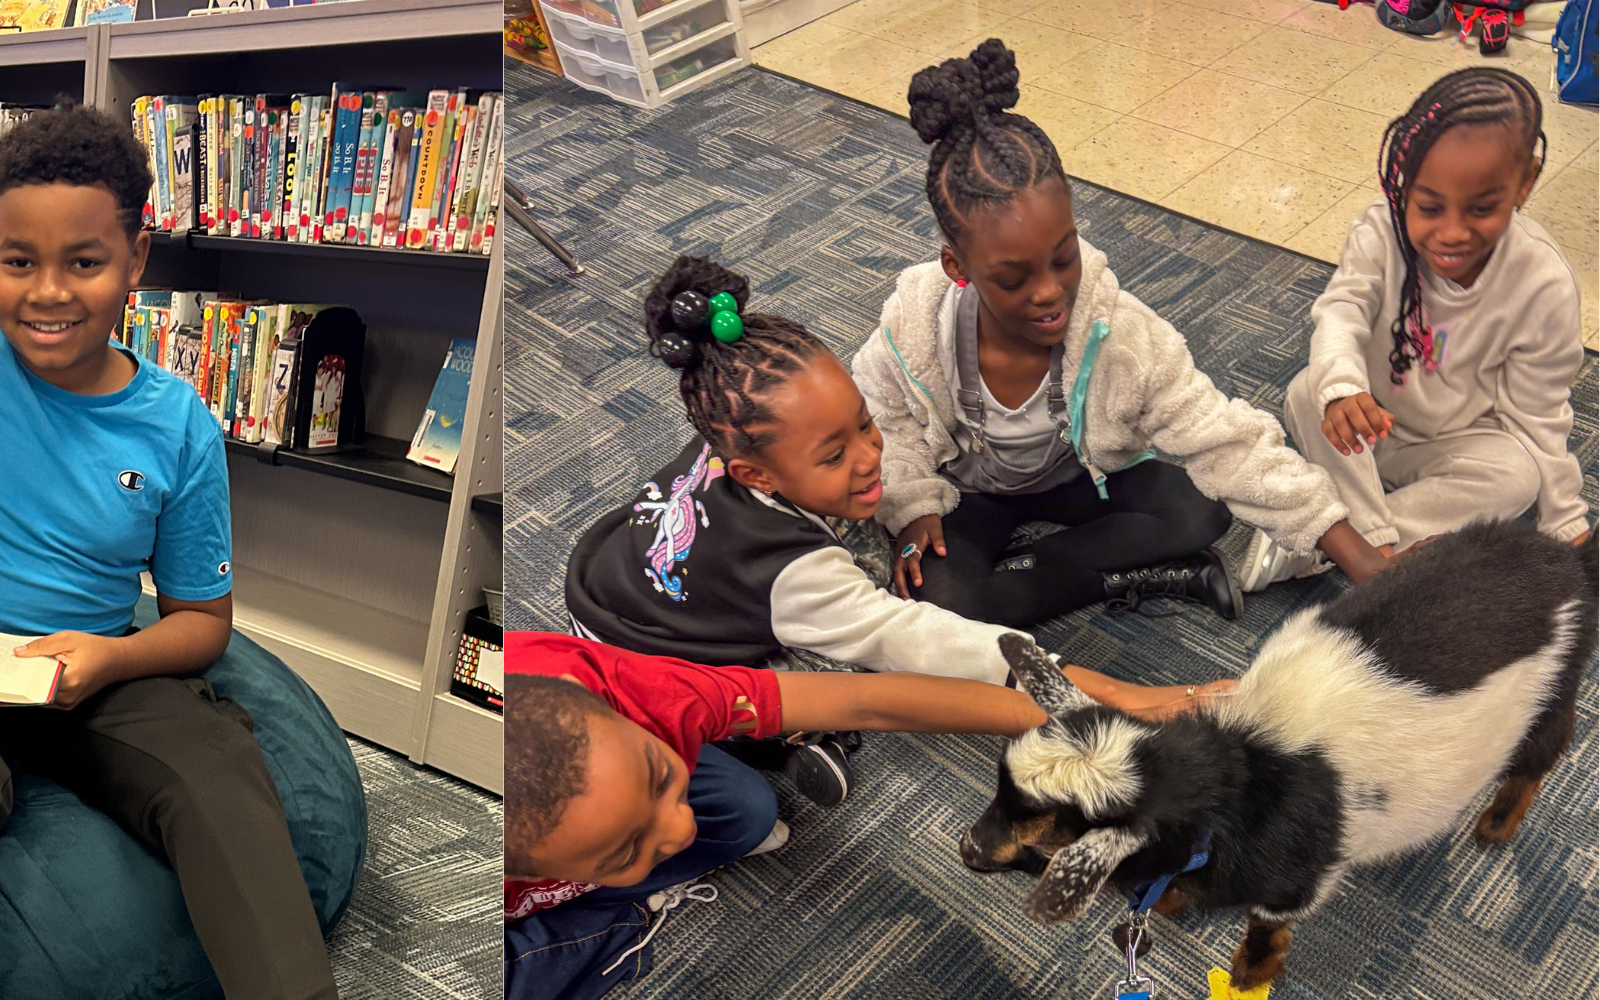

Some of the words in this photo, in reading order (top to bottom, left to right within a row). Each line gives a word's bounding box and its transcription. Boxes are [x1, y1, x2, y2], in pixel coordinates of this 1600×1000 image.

[473, 111, 487, 148] harlotte's
[490, 115, 500, 149] harlotte's
[174, 147, 191, 175] W
[199, 134, 207, 164] BEAST
[344, 156, 353, 166] B.
[345, 143, 354, 154] So
[469, 148, 479, 168] Web
[343, 166, 350, 174] It
[355, 156, 366, 188] PIE
[366, 156, 374, 188] PIE
[382, 158, 390, 170] So
[418, 130, 433, 200] COUNTDOWN
[380, 174, 388, 185] B.
[200, 322, 209, 366] RONT
[175, 346, 185, 371] X
[190, 351, 199, 376] Y
[276, 364, 288, 389] Z
